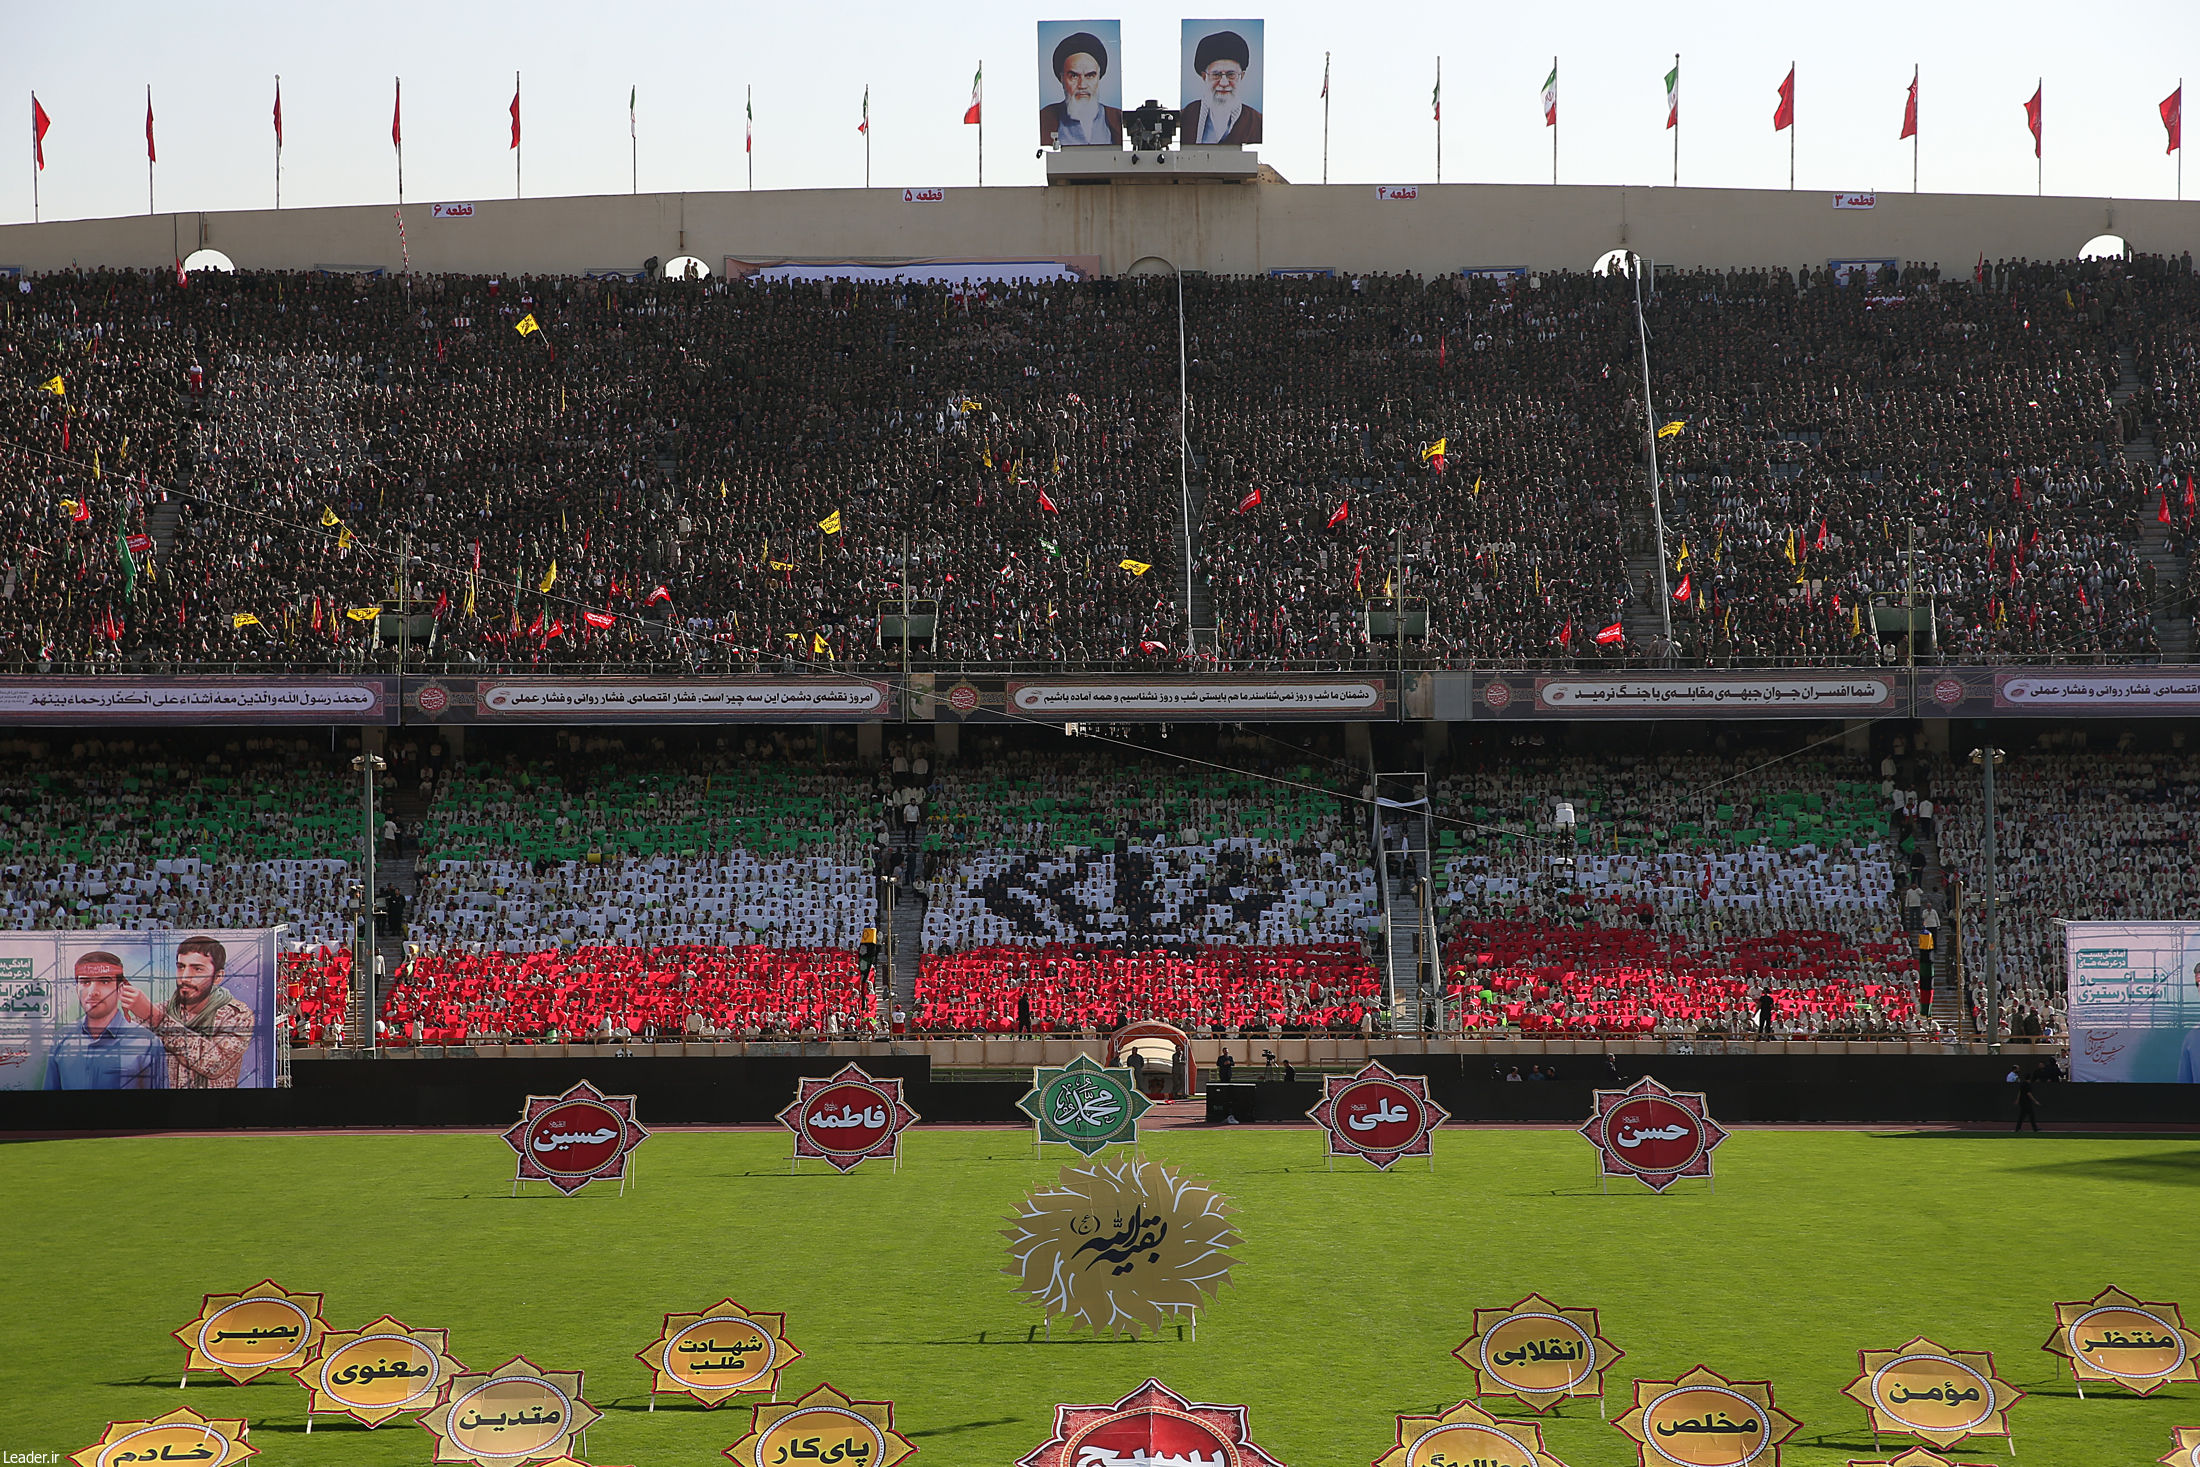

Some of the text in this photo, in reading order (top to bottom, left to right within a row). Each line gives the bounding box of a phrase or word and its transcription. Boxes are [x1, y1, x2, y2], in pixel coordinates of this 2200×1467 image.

[904, 188, 943, 202] قطعه ۵
[1378, 186, 1417, 200] قطعه ۴
[1834, 193, 1875, 207] قطعه ۳
[433, 203, 473, 217] قطعه ۶
[1070, 691, 1092, 703] آماده
[1239, 692, 1249, 701] ما
[1313, 691, 1330, 703] شب
[1330, 691, 1339, 701] ما
[1338, 690, 1370, 702] دشمنان
[1616, 686, 1651, 701] جنگ
[1651, 687, 1661, 701] با
[1801, 685, 1849, 699] افسران
[1850, 685, 1875, 698] شما
[2030, 686, 2059, 698] عملی
[2062, 685, 2088, 698] فشار
[2095, 685, 2123, 698] روانی
[2126, 684, 2151, 697] فشار
[511, 693, 541, 706] عملی
[541, 692, 566, 706] فشار
[566, 695, 573, 705] و
[573, 693, 599, 706] روانی
[600, 691, 625, 705] فشار
[672, 691, 696, 704] فشار
[726, 693, 745, 707] چیز
[746, 692, 763, 703] سه
[764, 692, 780, 704] این
[782, 692, 812, 704] دشمن
[848, 692, 874, 704] امروز
[1043, 692, 1070, 705] باشیم
[1093, 693, 1112, 703] همه
[1120, 692, 1158, 704] نشناسیم
[1159, 693, 1174, 705] روز
[1180, 692, 1198, 703] شب
[1199, 692, 1227, 704] بایستی
[1227, 693, 1240, 704] هم
[1295, 692, 1308, 703] روز
[2079, 974, 2086, 986] و
[41, 1002, 50, 1016] و
[808, 1104, 886, 1129] فاطمه
[1348, 1098, 1409, 1131] علی
[533, 1127, 618, 1152] حسین
[1617, 1124, 1690, 1148] حسن
[209, 1324, 300, 1345] بصیر
[2082, 1330, 2176, 1352] منتظر
[678, 1336, 763, 1354] شهادت
[1493, 1338, 1584, 1367] انقلابی
[690, 1355, 745, 1374] طلب
[331, 1358, 429, 1386] معنوی
[1889, 1381, 1980, 1406] مؤمن
[459, 1405, 561, 1432] متدین
[1657, 1411, 1759, 1436] مخلص
[113, 1442, 214, 1467] خادم
